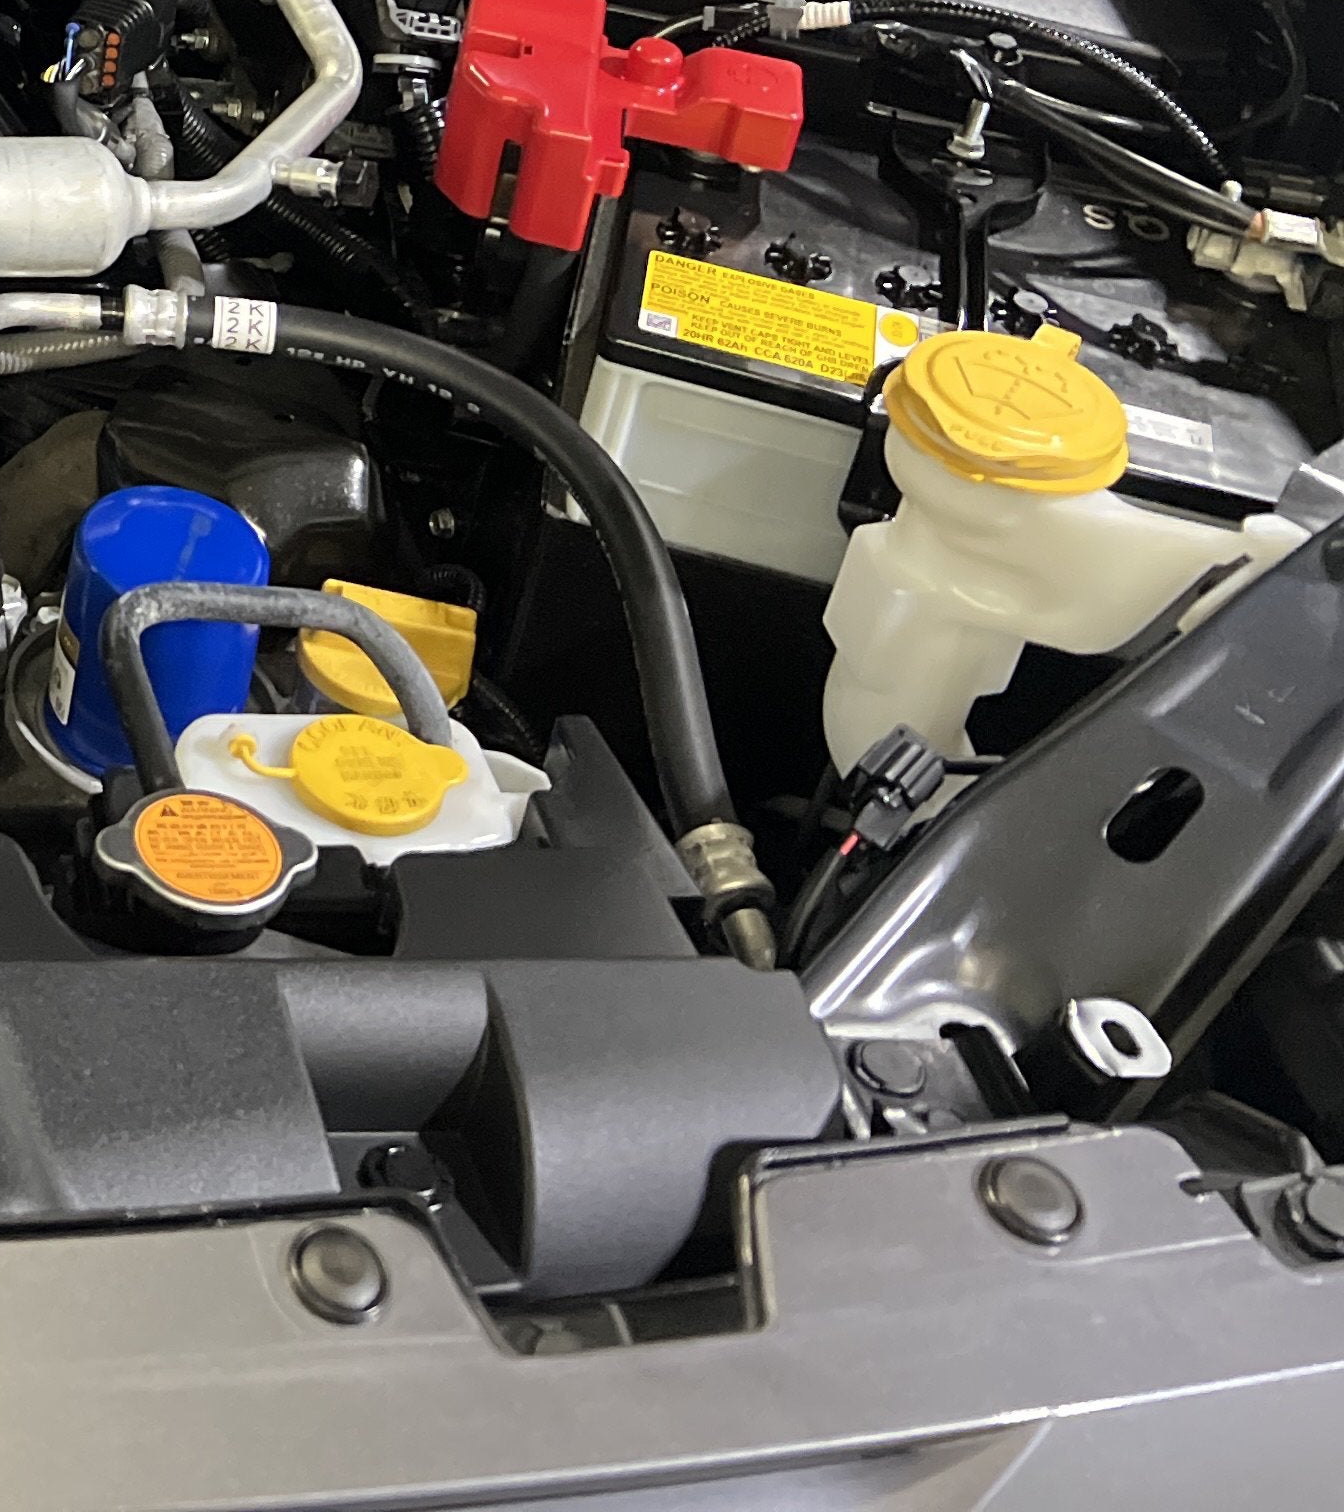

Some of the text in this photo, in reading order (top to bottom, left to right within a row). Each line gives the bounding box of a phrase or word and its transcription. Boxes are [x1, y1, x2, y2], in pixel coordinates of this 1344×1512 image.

[654, 254, 717, 277] DANGER
[722, 272, 777, 290] EXPLOSIVE
[227, 318, 263, 336] 2 K
[228, 301, 264, 317] 2 K
[651, 283, 842, 337] POISON CAUSES SEVERE BURNS
[245, 338, 261, 351] K
[683, 328, 716, 343] 20HR
[718, 338, 748, 352] 62Ah
[754, 347, 782, 361] CCA
[784, 353, 814, 369] 620A
[690, 322, 718, 334] KEEP
[720, 329, 741, 341] OUT
[742, 334, 758, 346] OF
[760, 338, 797, 353] REACH
[798, 348, 814, 359] OF
[691, 314, 718, 327] KEEP
[721, 320, 747, 334] VENT
[750, 327, 779, 341] CAPS
[782, 336, 811, 349] TIGHT
[813, 344, 836, 356] AND
